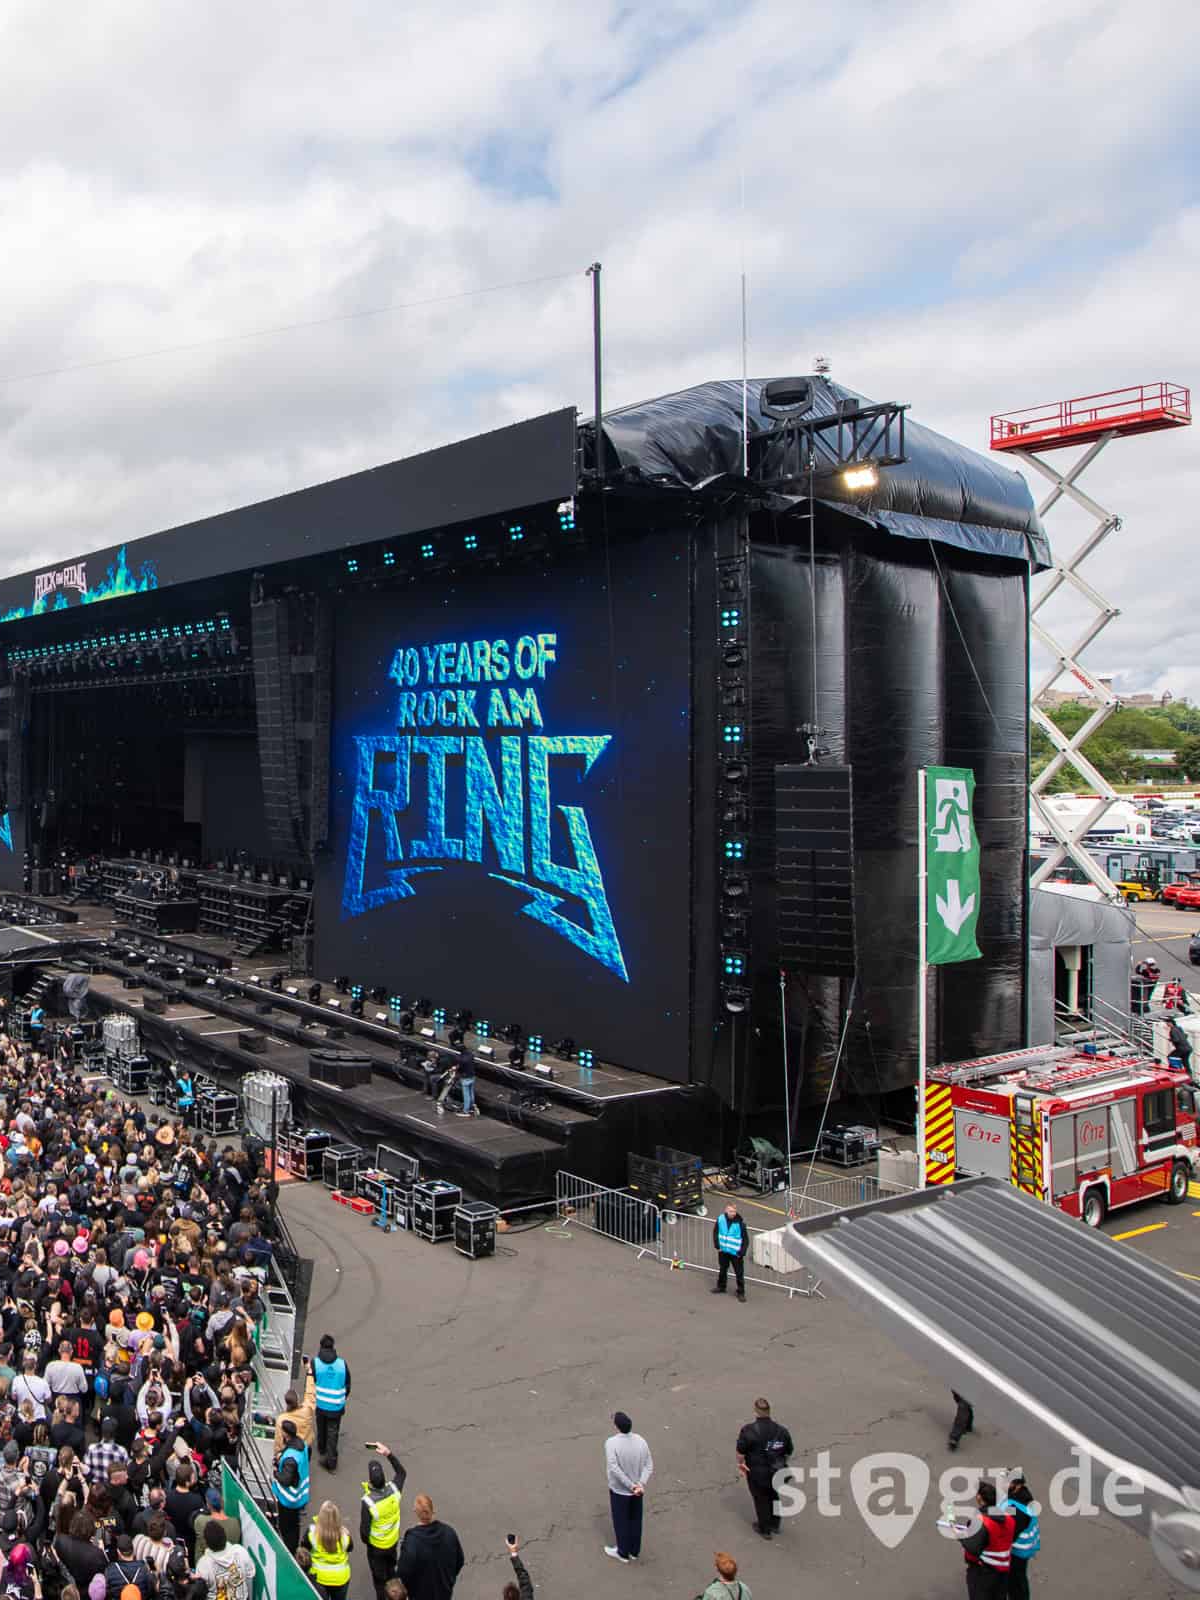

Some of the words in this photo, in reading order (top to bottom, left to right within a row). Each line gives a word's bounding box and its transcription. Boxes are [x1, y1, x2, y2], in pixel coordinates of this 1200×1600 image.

[34, 571, 56, 602] ROCK
[64, 562, 87, 594] RING
[388, 648, 420, 686] 40
[422, 640, 511, 685] YEARS
[514, 633, 557, 681] OF
[399, 690, 480, 728] ROCK
[487, 687, 544, 728] AM
[341, 735, 629, 983] RING
[979, 1130, 1002, 1144] 112
[1090, 1125, 1105, 1141] 112
